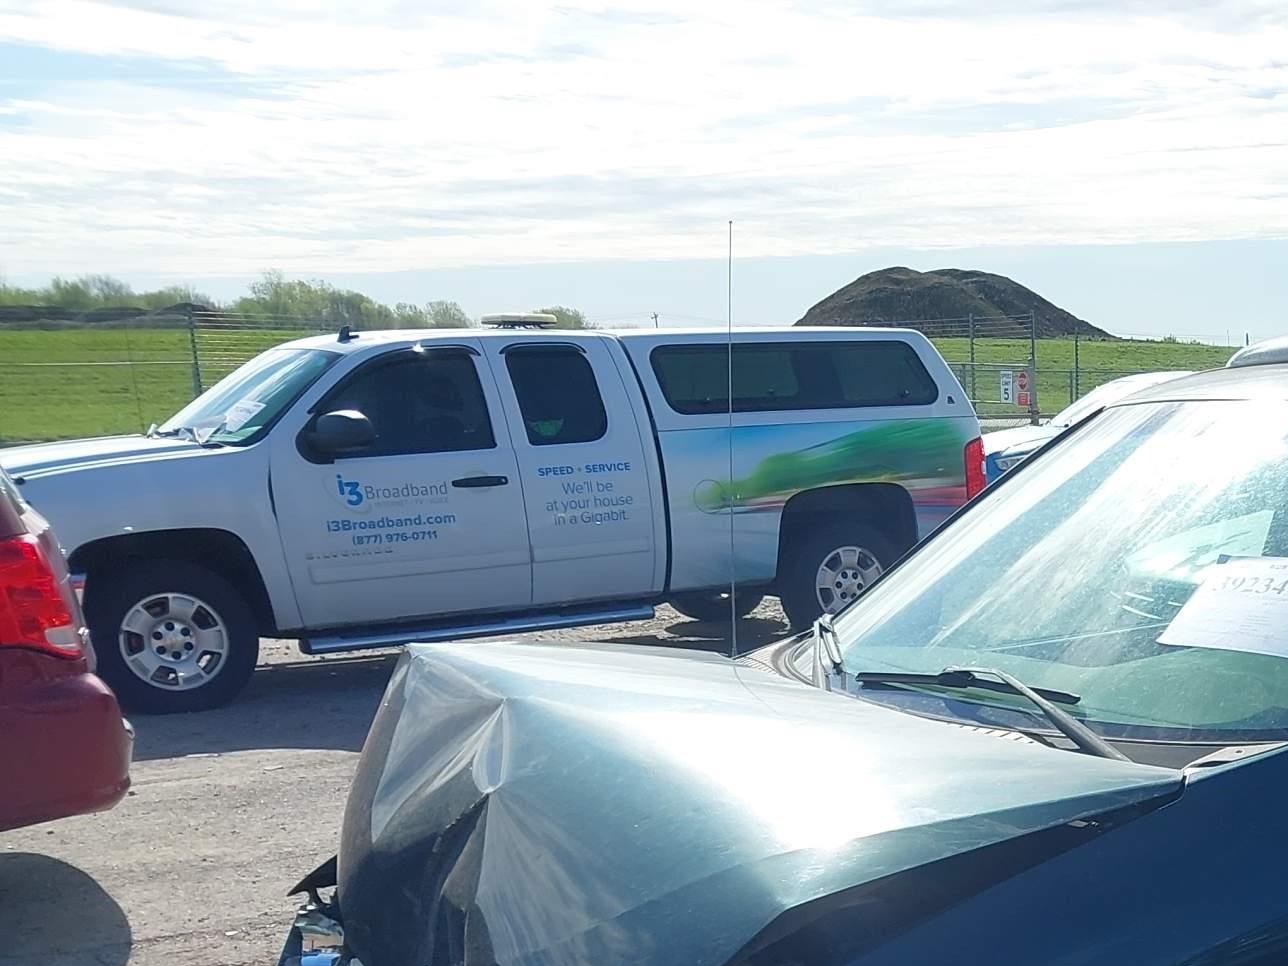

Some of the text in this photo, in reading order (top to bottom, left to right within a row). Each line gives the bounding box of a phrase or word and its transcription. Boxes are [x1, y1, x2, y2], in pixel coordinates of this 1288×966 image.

[1003, 388, 1009, 401] 5
[537, 462, 631, 477] SPEED SERVICE
[364, 481, 448, 500] Broadband
[562, 480, 614, 495] We'll be
[545, 495, 633, 513] at your house
[326, 513, 456, 533] i3Broadband.com
[553, 513, 566, 526] in
[569, 515, 577, 525] a
[352, 530, 438, 547] (877) 976-0711
